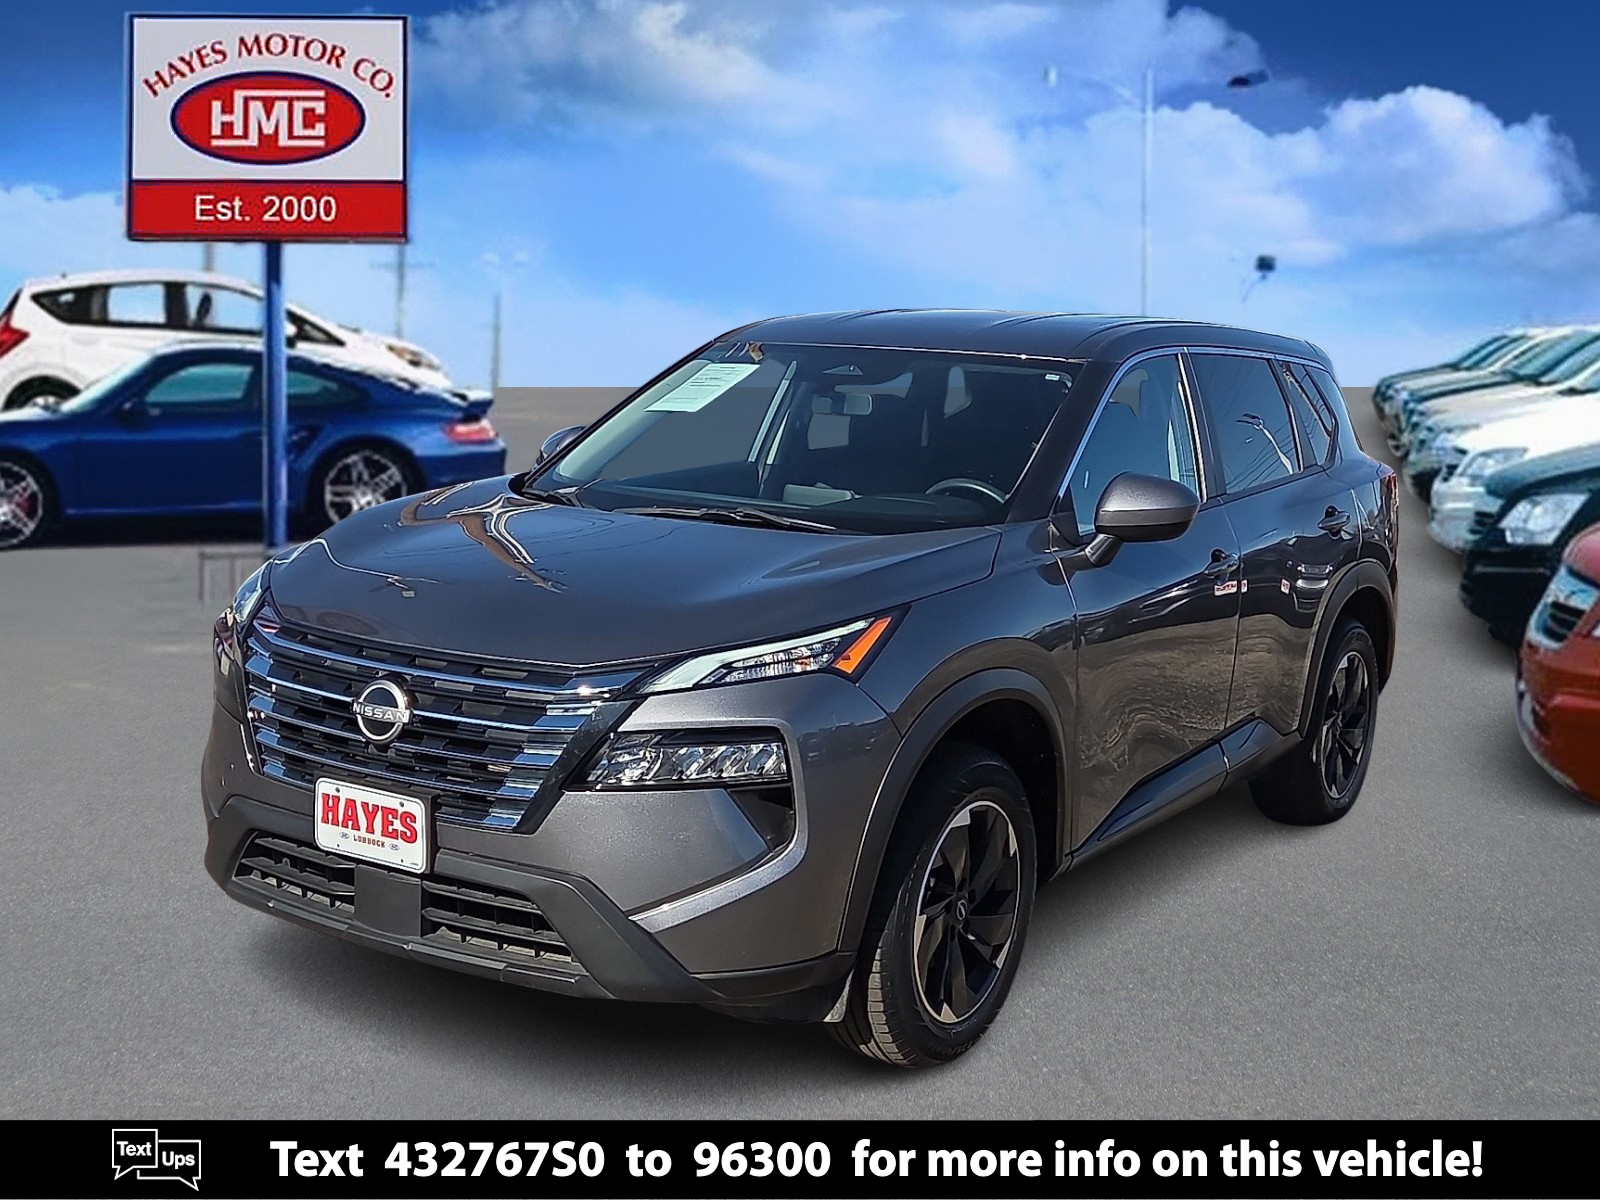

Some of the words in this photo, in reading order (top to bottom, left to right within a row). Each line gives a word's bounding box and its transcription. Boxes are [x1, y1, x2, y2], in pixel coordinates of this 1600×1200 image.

[143, 40, 228, 98] HAYES
[237, 32, 347, 71] MOTOR
[352, 57, 395, 98] CO.
[210, 88, 326, 147] HMC
[194, 194, 250, 222] Est.
[262, 196, 337, 222] 2000
[352, 702, 411, 723] NISSAN
[321, 792, 418, 844] HAYES
